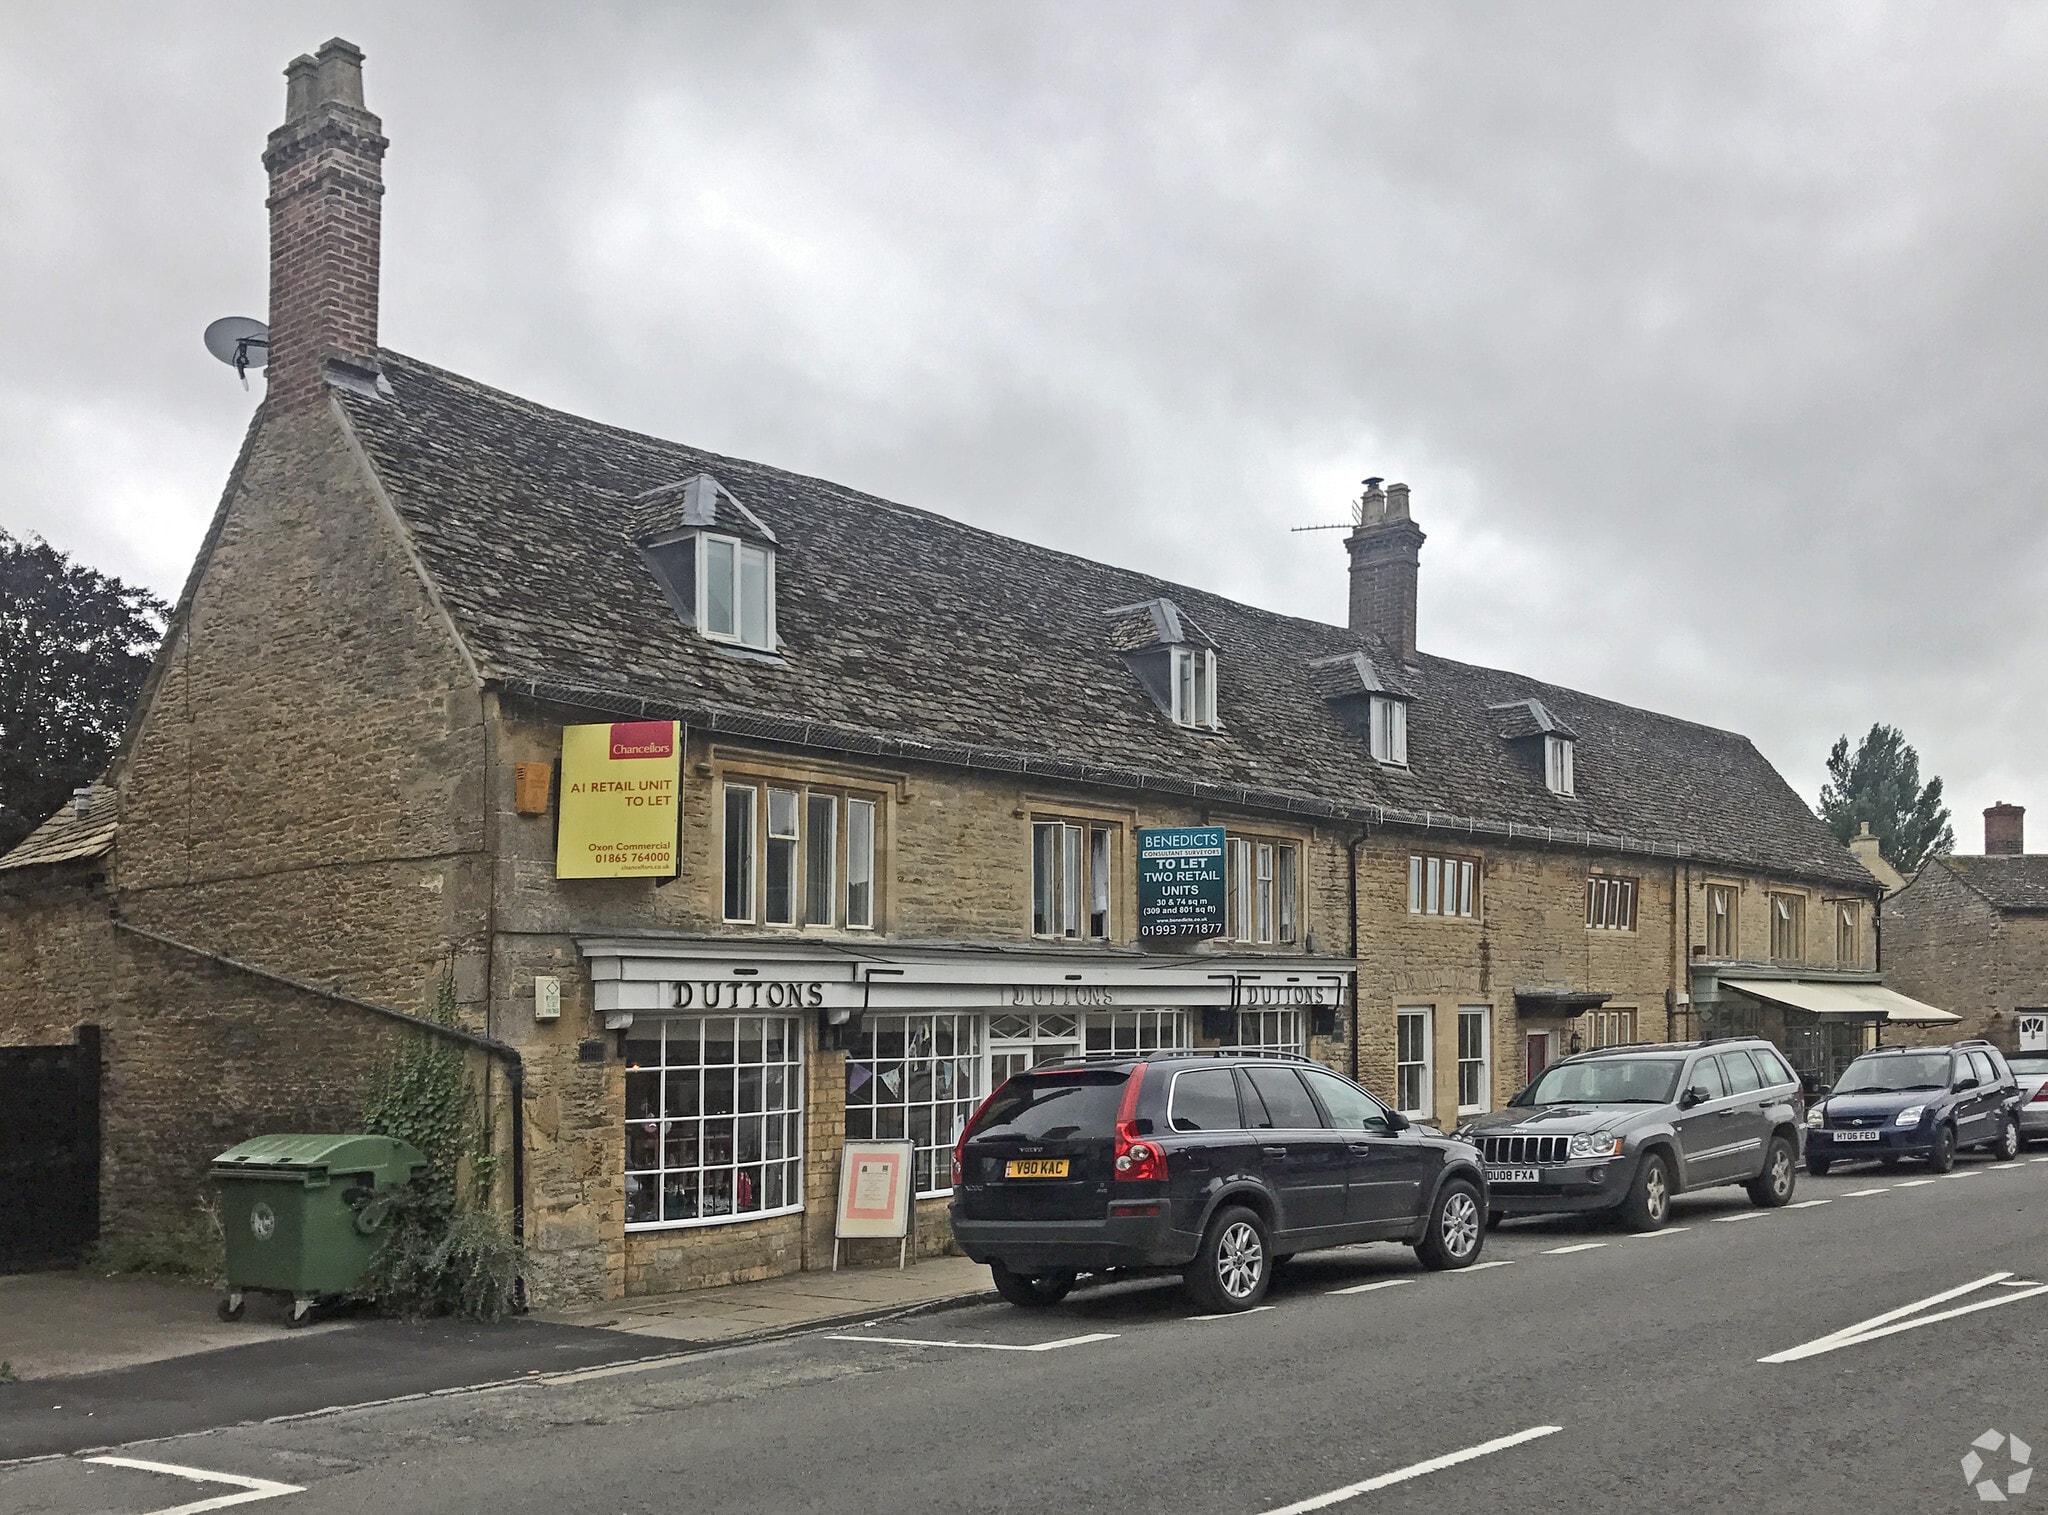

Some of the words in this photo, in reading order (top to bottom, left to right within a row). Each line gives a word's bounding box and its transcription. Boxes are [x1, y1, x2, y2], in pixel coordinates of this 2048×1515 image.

[613, 742, 669, 754] Chancellors
[591, 781, 635, 792] RETAIL
[639, 780, 672, 790] UNIT
[625, 796, 644, 807] TO
[648, 796, 672, 806] LET
[588, 843, 613, 851] Oxon
[616, 842, 670, 851] Commercial
[1145, 834, 1218, 848] BENEDICTS
[595, 853, 627, 863] 01865
[632, 852, 670, 862] 764000
[1156, 860, 1176, 869] TO
[1180, 858, 1208, 869] LET
[1144, 872, 1173, 882] TWO
[1176, 871, 1220, 881] RETAIL
[1162, 885, 1199, 896] UNITS
[1143, 907, 1160, 916] (309
[1207, 905, 1216, 914] ft)
[1141, 925, 1177, 936] 01993
[1180, 923, 1222, 935] 771877
[672, 982, 823, 1008] DUTTONS
[1247, 986, 1324, 1006] DUTTONS
[1040, 1161, 1063, 1174] KAC
[1488, 1171, 1512, 1180] DU08
[1515, 1170, 1534, 1180] FXA
